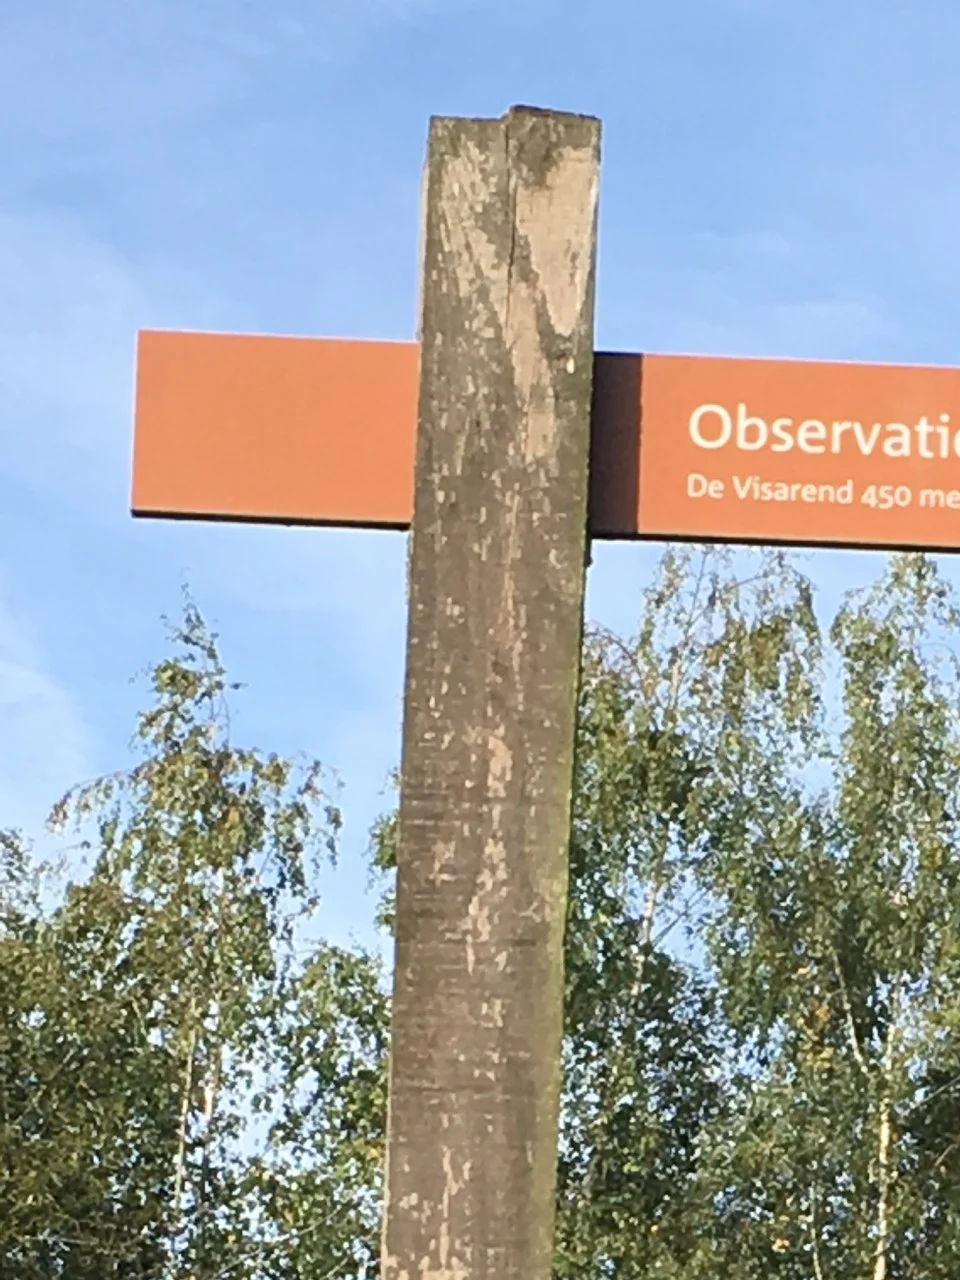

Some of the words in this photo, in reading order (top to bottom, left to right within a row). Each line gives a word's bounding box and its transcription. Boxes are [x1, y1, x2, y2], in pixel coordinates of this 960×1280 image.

[687, 473, 725, 499] De
[732, 475, 853, 505] Visarend
[861, 485, 913, 510] 450
